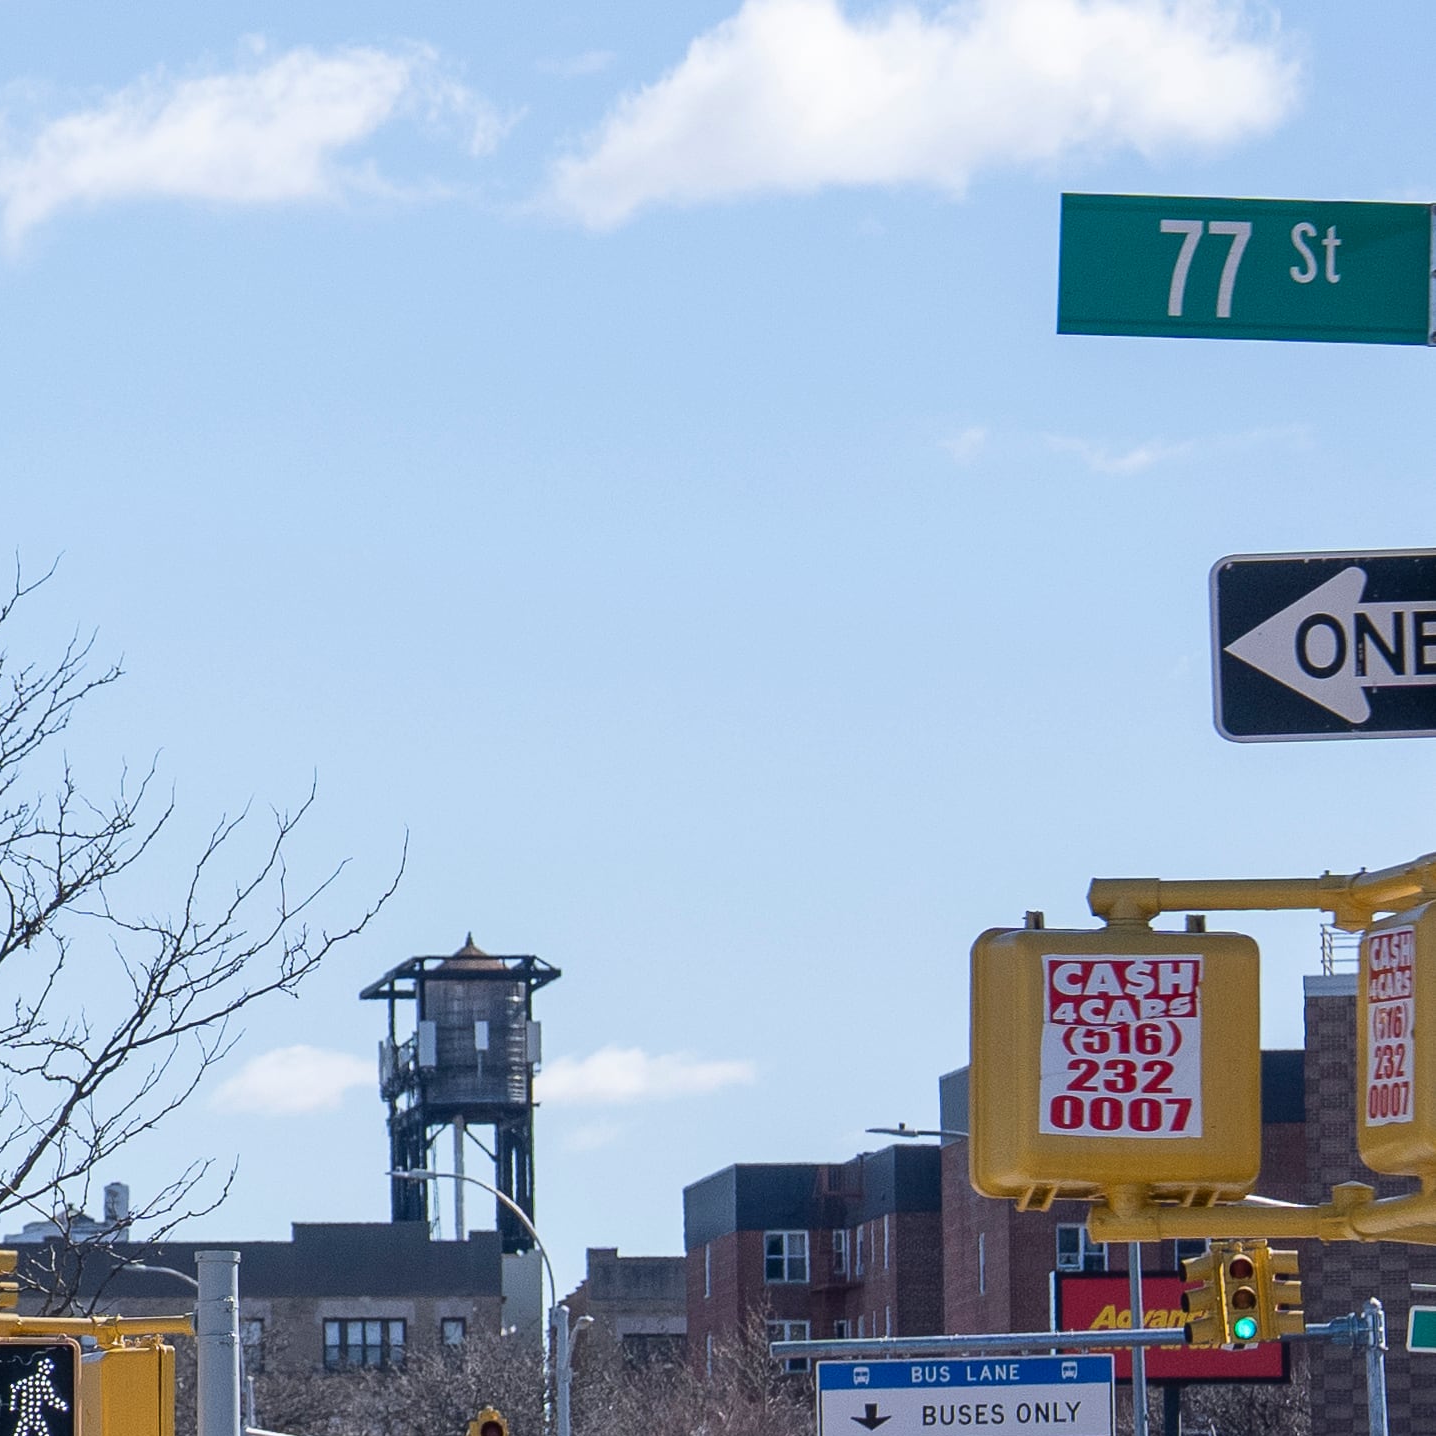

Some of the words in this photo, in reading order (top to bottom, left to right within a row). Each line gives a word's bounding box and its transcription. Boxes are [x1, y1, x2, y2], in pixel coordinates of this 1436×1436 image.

[1159, 219, 1253, 318] 77
[1289, 221, 1343, 285] St
[1062, 1020, 1183, 1057] (516)
[1372, 1002, 1409, 1043] (516)
[1066, 1058, 1175, 1094] 232
[1373, 1043, 1405, 1080] 232
[1050, 1094, 1193, 1132] 0007
[1368, 1081, 1410, 1119] 0007
[910, 1366, 951, 1384] BUS
[966, 1363, 1021, 1382] LANE
[921, 1402, 1005, 1427] BUSES
[1015, 1400, 1082, 1424] ONLY
